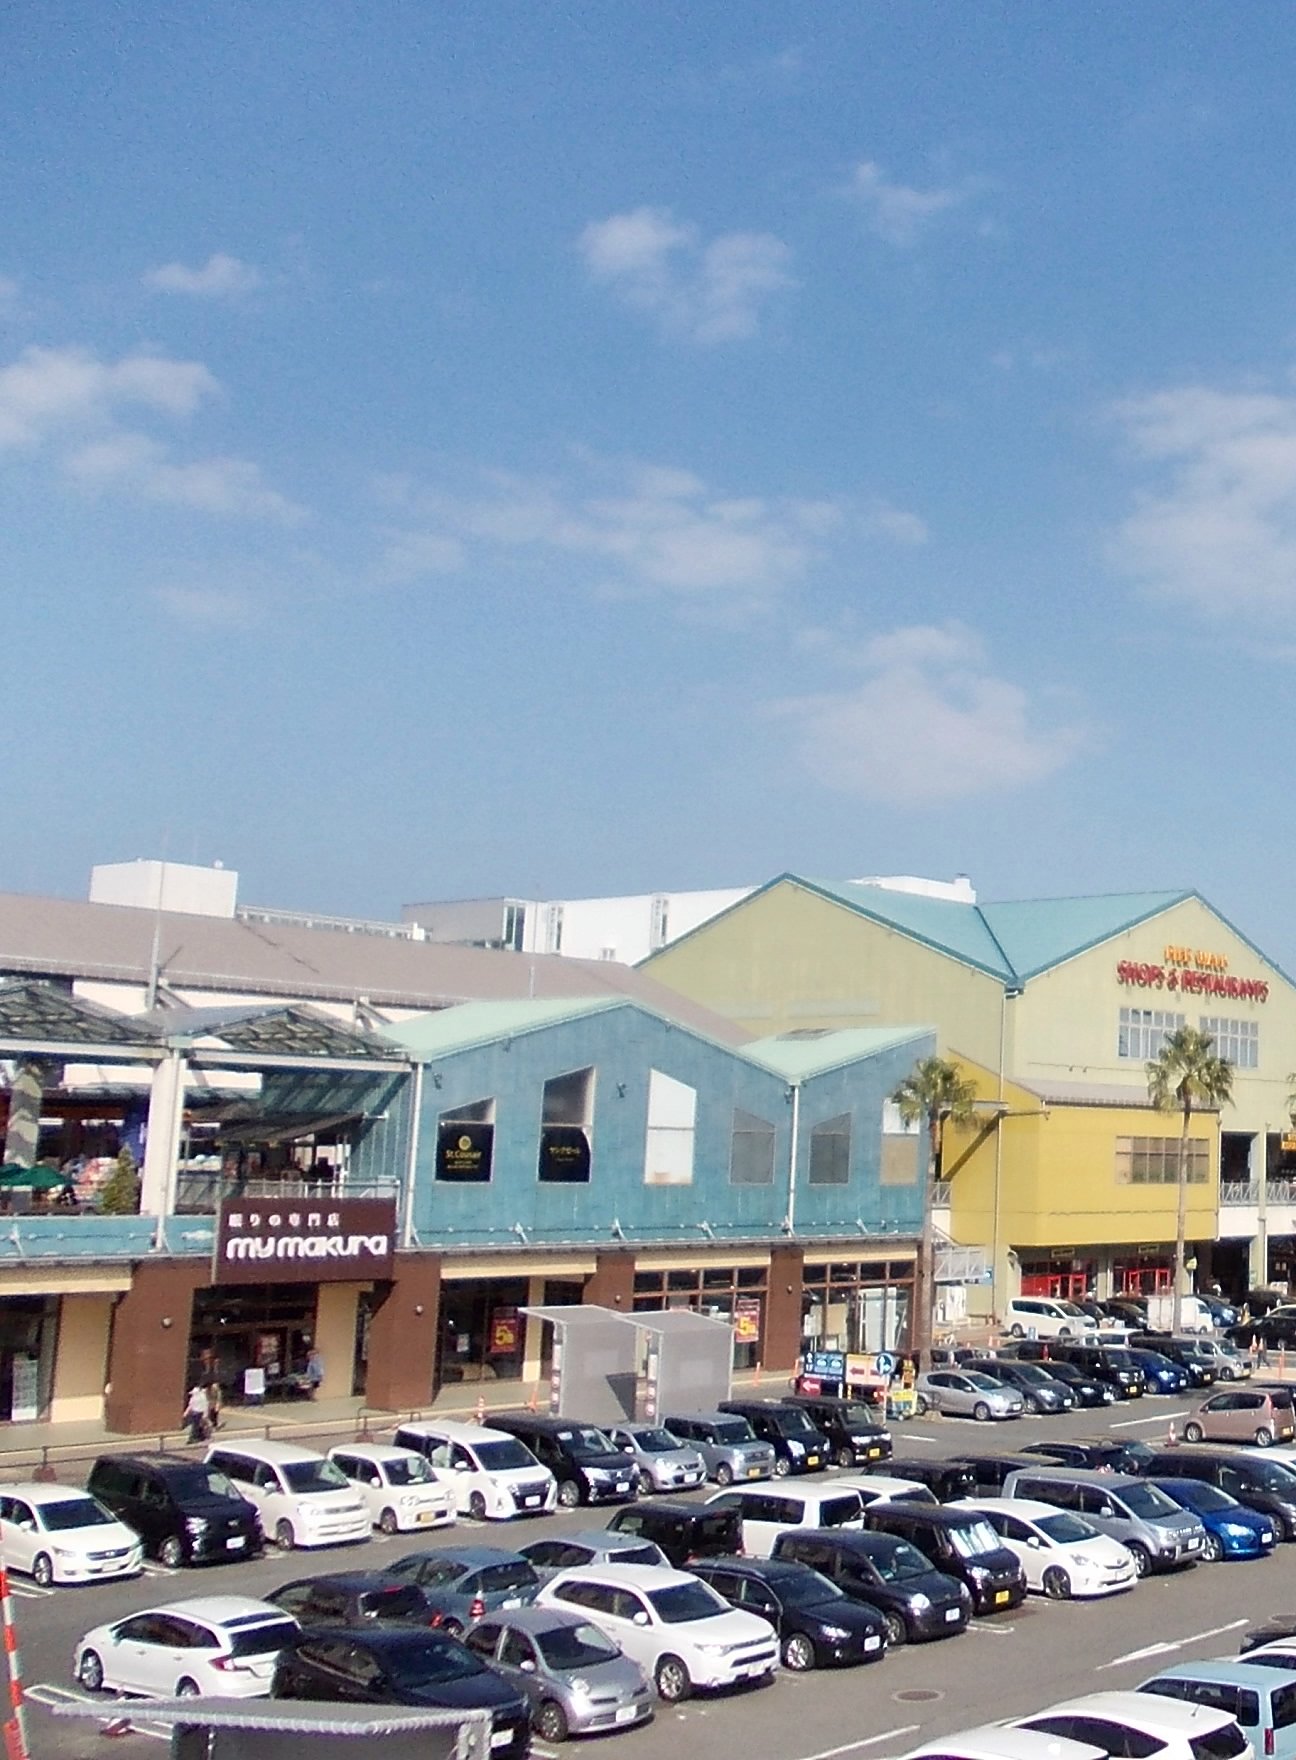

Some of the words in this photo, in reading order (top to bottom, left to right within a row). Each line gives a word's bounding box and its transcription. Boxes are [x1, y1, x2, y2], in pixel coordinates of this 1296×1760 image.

[1117, 960, 1164, 989] SHOPS
[1167, 968, 1179, 991] &
[1181, 969, 1270, 1003] RESTAURANTS
